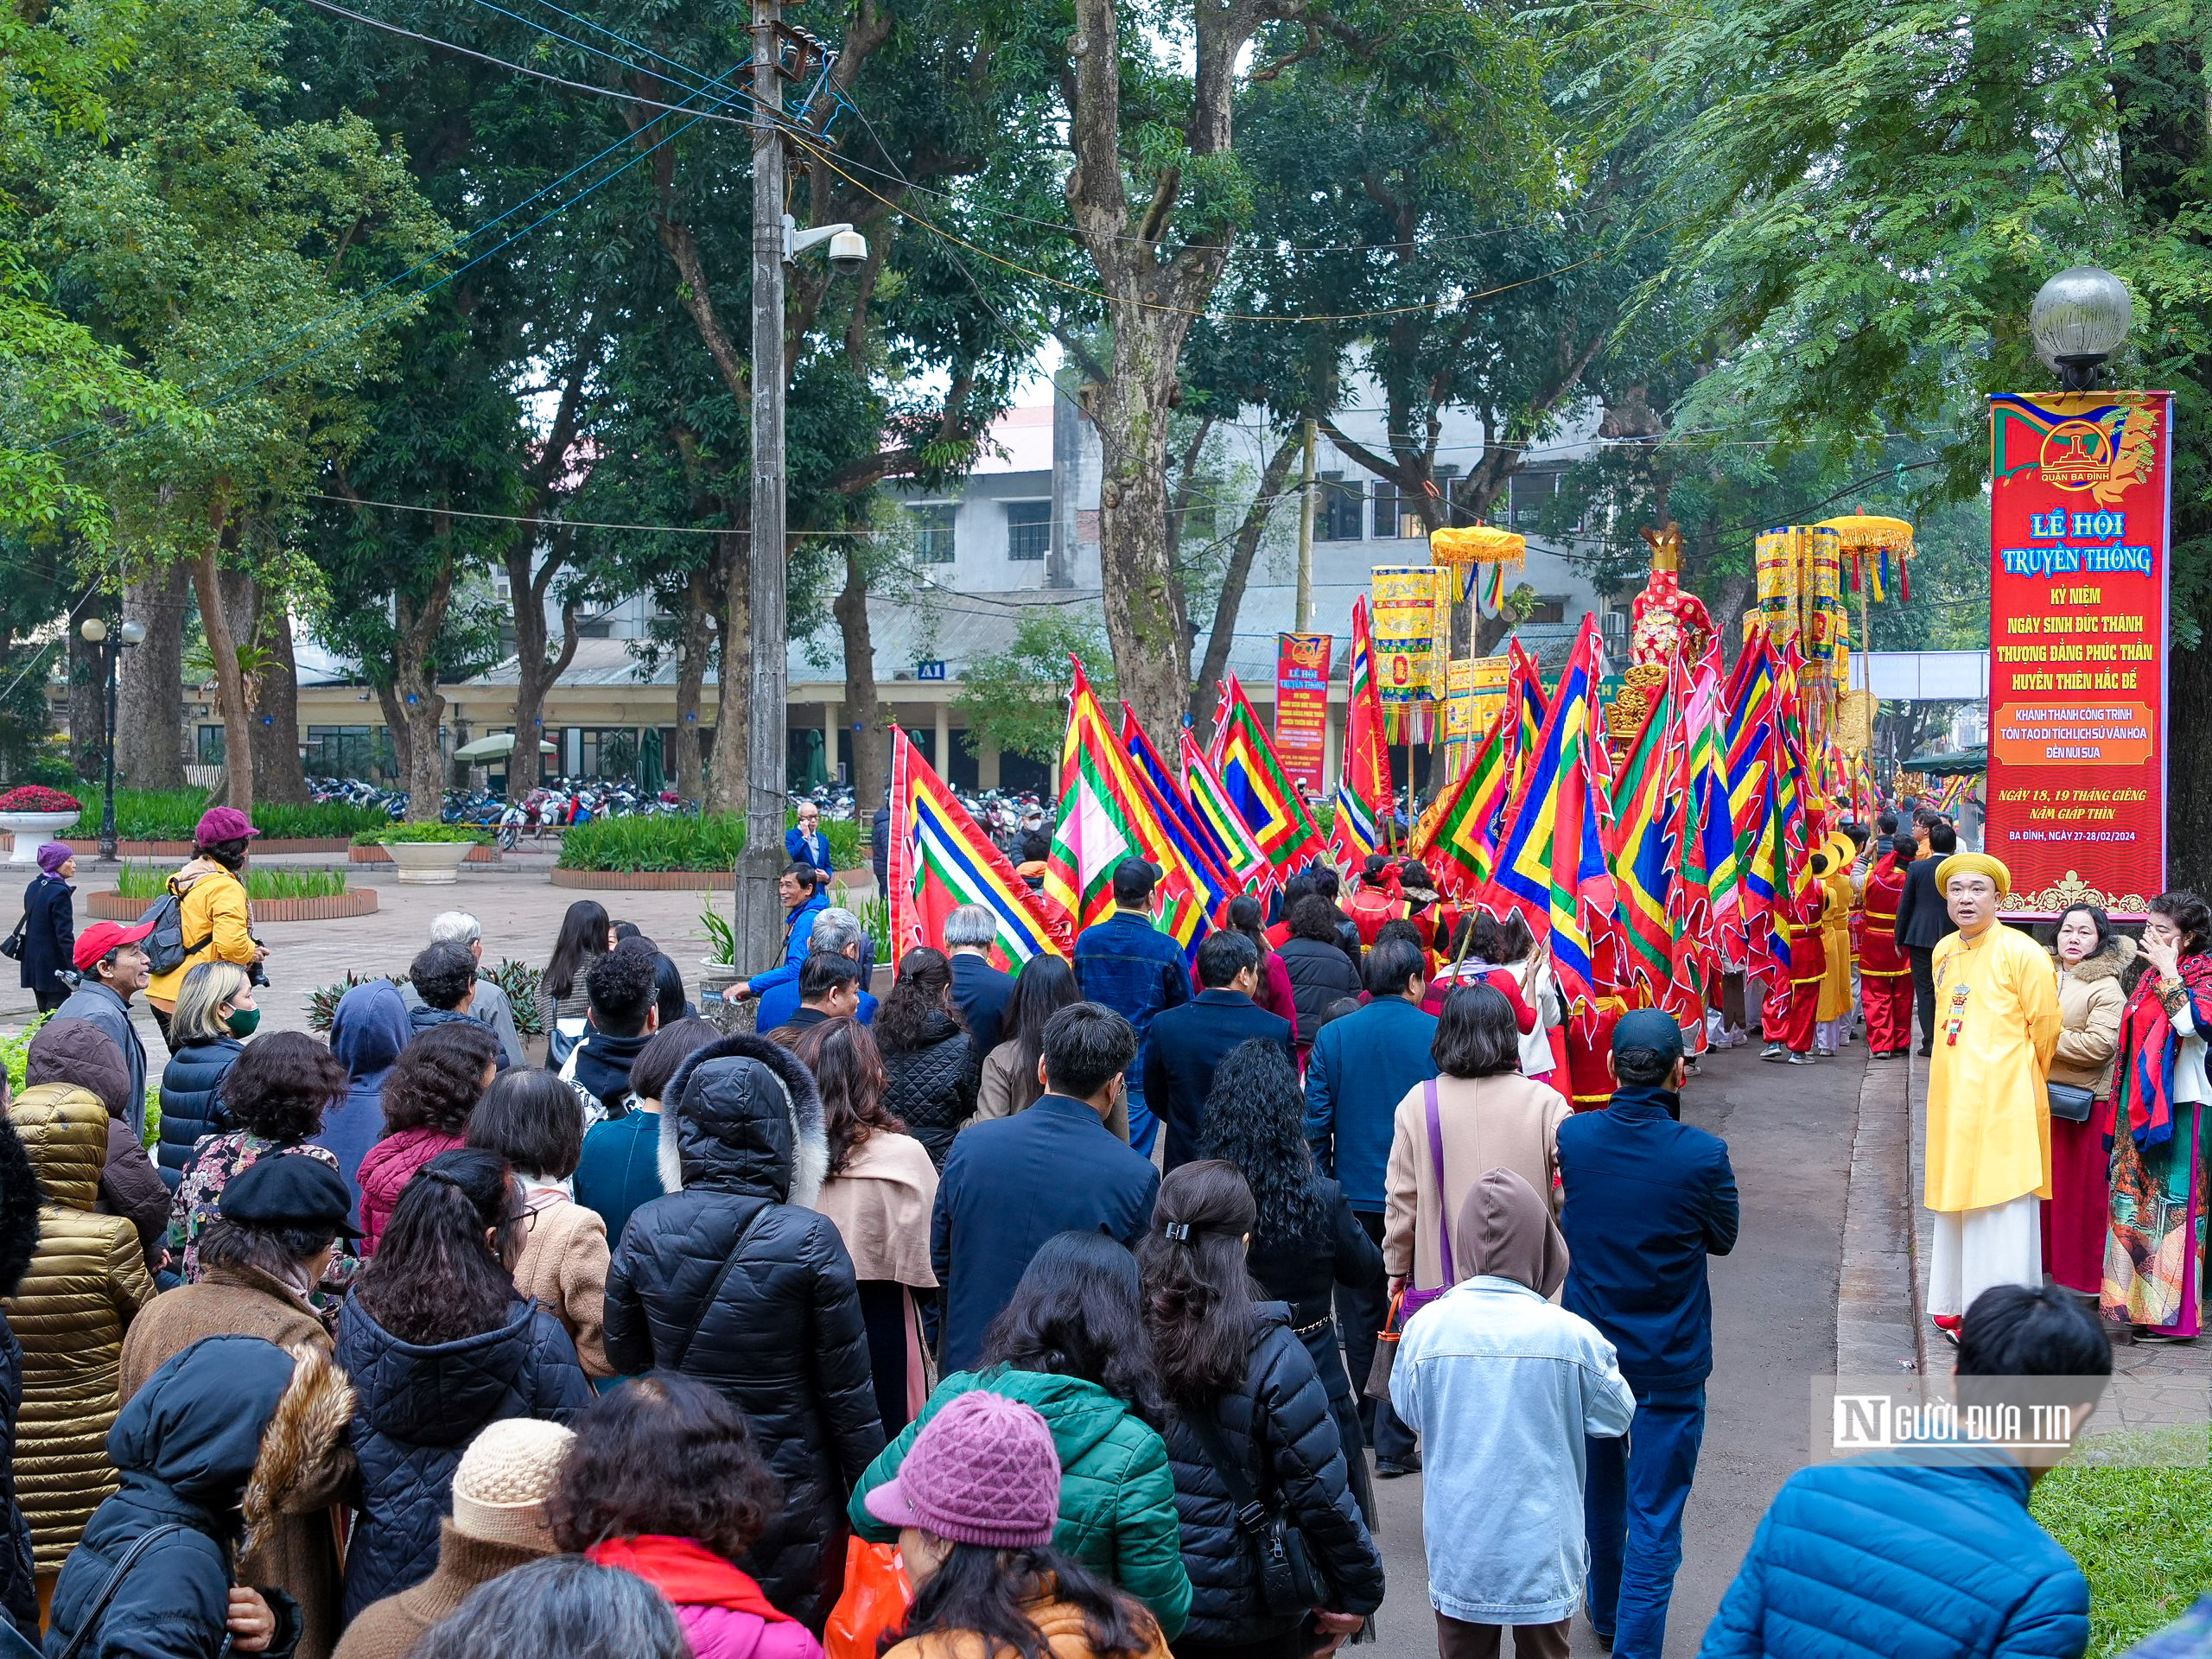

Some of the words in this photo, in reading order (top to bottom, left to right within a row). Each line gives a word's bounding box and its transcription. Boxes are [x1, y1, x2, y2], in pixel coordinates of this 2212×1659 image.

[2041, 472, 2068, 483] QUẬN
[2087, 471, 2109, 480] ĐÌNH
[2031, 508, 2066, 538] LỄ
[2071, 509, 2125, 540] HỘI
[2002, 542, 2081, 578] TRUYỀN
[2083, 541, 2152, 576] THỐNG
[2050, 584, 2066, 605] KỶ
[2069, 584, 2101, 607] NIỆM
[2007, 614, 2041, 633] NGÀY
[2043, 616, 2073, 633] SINH
[2075, 613, 2099, 632] ĐỨC
[2101, 613, 2144, 632] THÁNH
[1997, 645, 2047, 665] THƯỢNG
[2050, 638, 2083, 662] ĐẲNG
[2086, 641, 2117, 662] PHÚC
[2120, 638, 2153, 661] THẦN
[2012, 667, 2053, 690] HUYỀN
[2056, 670, 2092, 690] THIÊN
[2094, 666, 2119, 690] HẮC
[2121, 666, 2138, 690] ĐẾ
[2015, 707, 2047, 721] KHÁNH
[2048, 707, 2078, 721] THÀNH
[2079, 707, 2105, 721] CÔNG
[2105, 706, 2133, 721] TRÌNH
[2000, 726, 2020, 740] TÔN
[2020, 728, 2041, 741] TẠO
[2042, 728, 2051, 740] DI
[2052, 726, 2074, 740] TÍCH
[2074, 728, 2092, 741] LỊCH
[2092, 725, 2106, 740] SỬ
[2106, 726, 2128, 740] VĂN
[2129, 726, 2147, 739] HÓA
[2046, 743, 2065, 759] ĐỀN
[2065, 744, 2081, 759] NÚI
[1998, 787, 2031, 801] NGÀY
[2032, 790, 2051, 803] 18,
[2055, 790, 2070, 801] 19
[2072, 787, 2111, 801] THÁNG
[2112, 787, 2147, 801] GIÊNG
[2029, 805, 2056, 819] NĂM
[2057, 805, 2085, 819] GIÁP
[2087, 805, 2116, 819] THÌN
[2009, 831, 2021, 841] BA
[2023, 830, 2047, 842] ĐÌNH,
[2049, 830, 2073, 841] NGÀY
[2074, 831, 2136, 842] 27-28/02/2024
